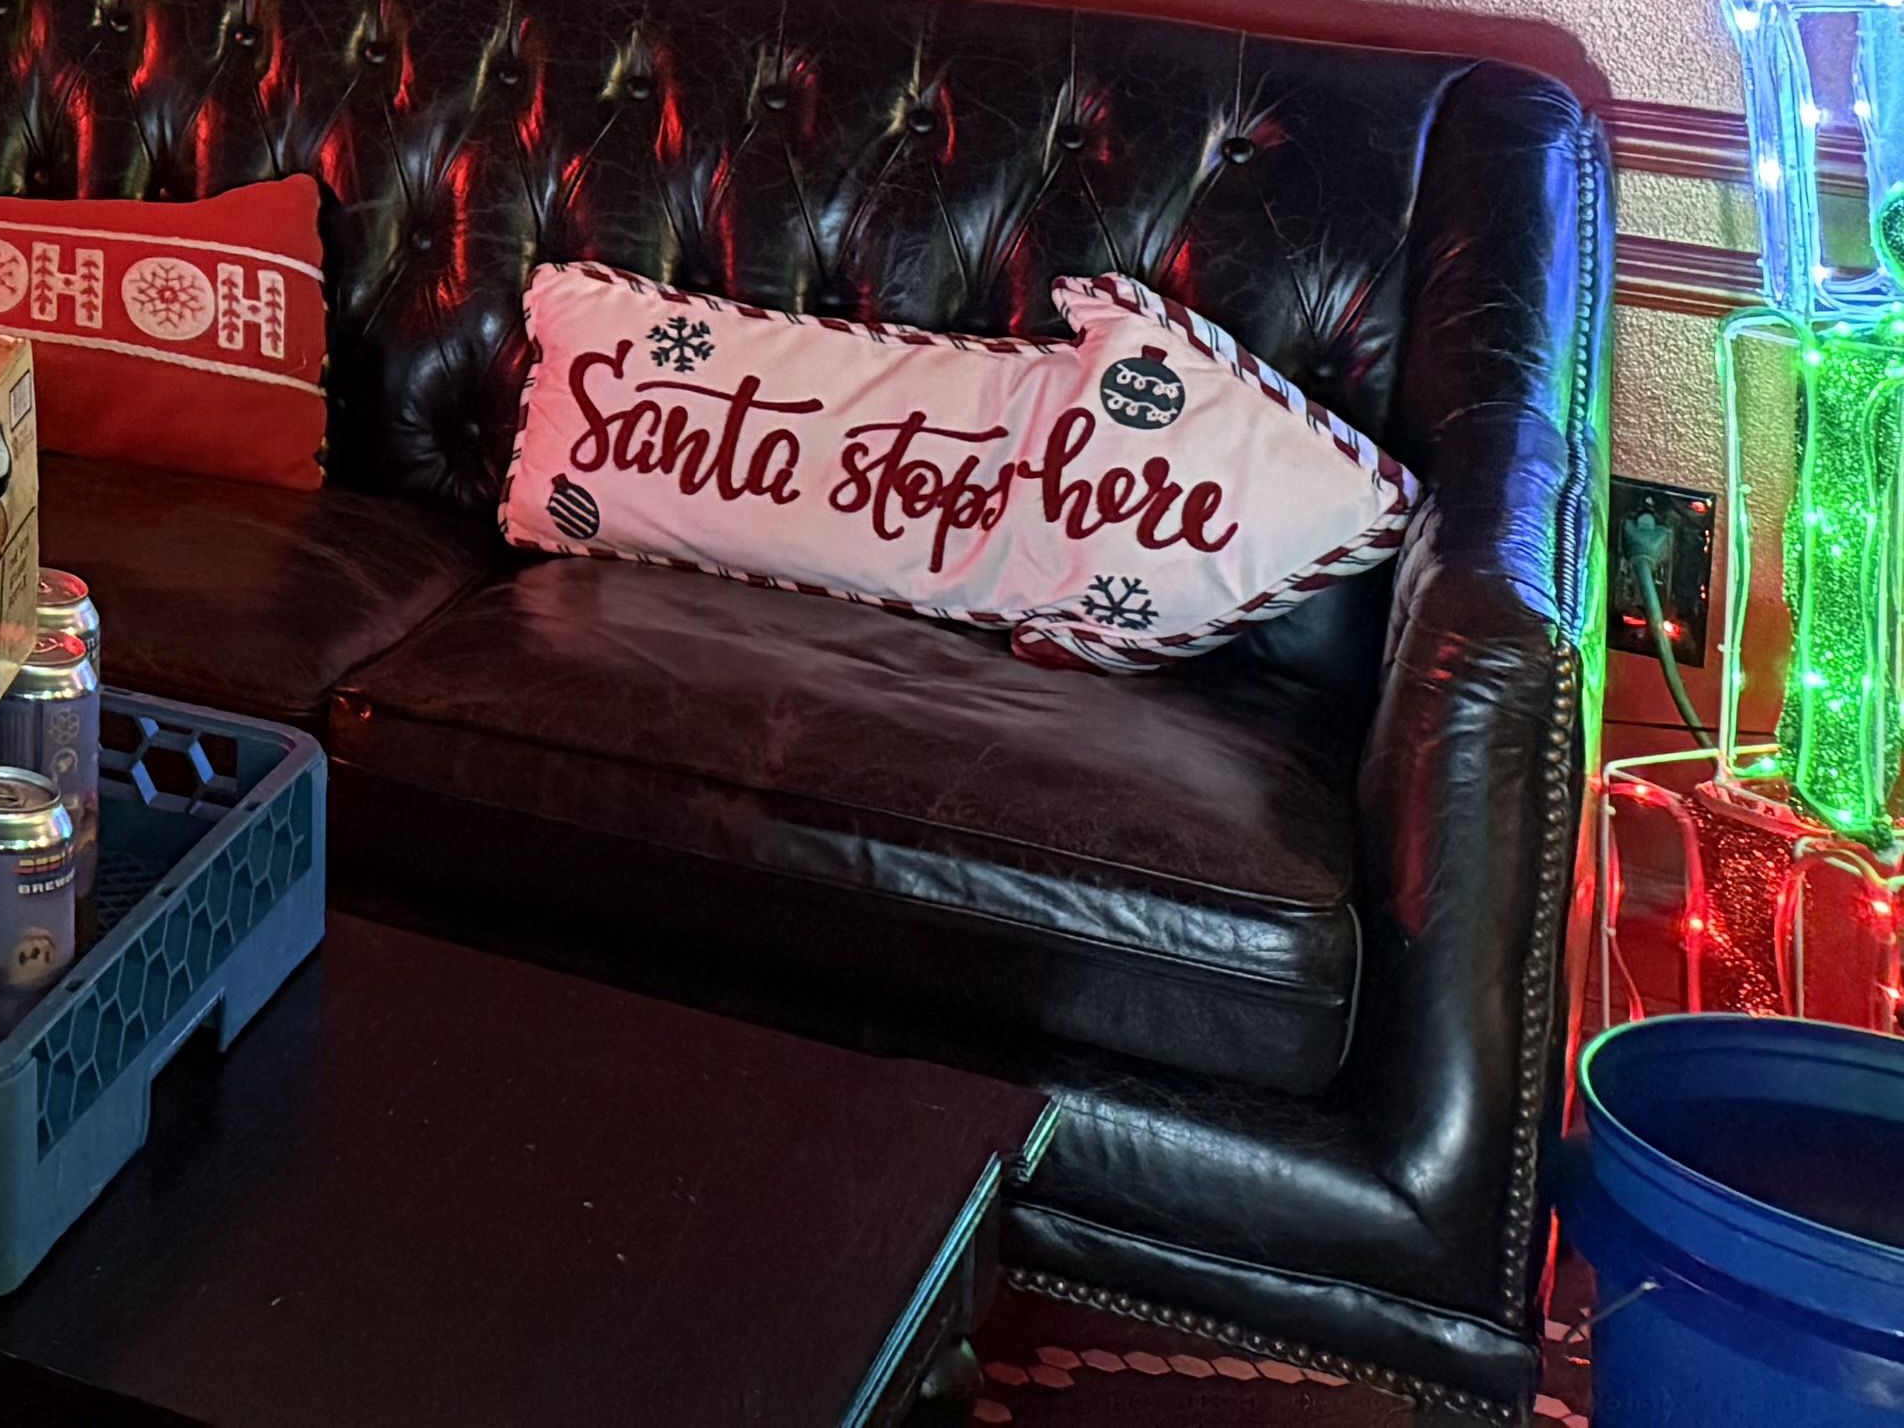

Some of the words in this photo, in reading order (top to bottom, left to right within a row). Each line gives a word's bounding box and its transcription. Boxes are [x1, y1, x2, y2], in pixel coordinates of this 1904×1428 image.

[568, 340, 823, 505] Santa
[829, 411, 1010, 574] stops
[1019, 407, 1238, 554] here
